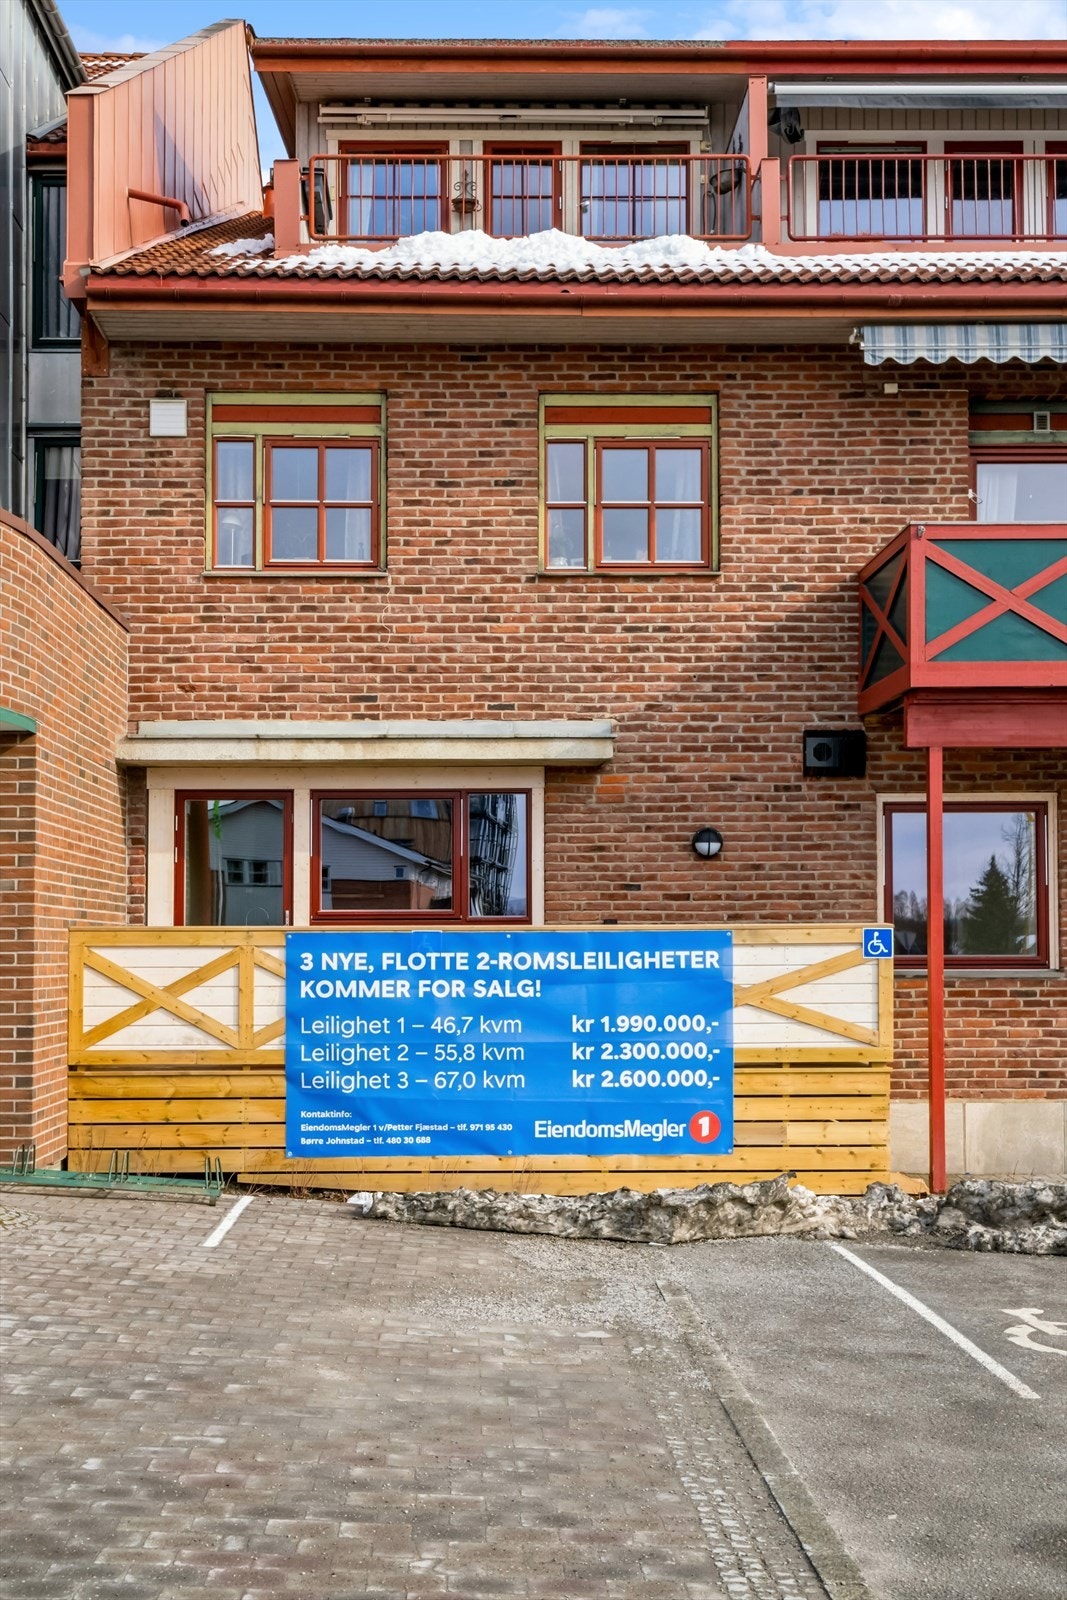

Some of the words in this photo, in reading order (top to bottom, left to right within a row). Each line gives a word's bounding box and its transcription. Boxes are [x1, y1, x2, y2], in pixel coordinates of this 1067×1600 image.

[300, 952, 314, 971] 3
[321, 952, 375, 974] NYE,
[381, 952, 469, 971] FLOTTE
[476, 950, 720, 971] 2-ROMSLEILIGHETER
[300, 979, 411, 999] KOMMER
[418, 979, 466, 998] FOR
[472, 979, 541, 999] SALG!
[301, 1015, 391, 1039] Leilighet
[397, 1016, 405, 1034] 1
[430, 1015, 474, 1036] 46,7
[479, 1015, 522, 1034] kvm
[571, 1014, 595, 1033] kr
[600, 1014, 720, 1035] 1.990.000,-
[300, 1042, 391, 1066] Leilighet
[397, 1044, 409, 1061] 2
[434, 1043, 476, 1063] 55,8
[482, 1042, 525, 1062] kvm
[572, 1042, 595, 1060] kr
[600, 1041, 721, 1062] 2.300.000,-
[301, 1070, 391, 1094] Leilighet
[397, 1071, 409, 1089] 3
[434, 1071, 476, 1091] 67,0
[483, 1070, 525, 1089] kvm
[572, 1069, 596, 1088] kr
[601, 1069, 720, 1089] 2.600.000,-
[300, 1110, 352, 1118] Kontaktinfo:
[300, 1123, 371, 1133] EiendomsMegler
[378, 1123, 414, 1132] v/Petter
[415, 1123, 449, 1133] Fjæstad
[456, 1123, 468, 1131] tlf.
[469, 1123, 484, 1131] 971
[485, 1123, 496, 1131] 95
[497, 1123, 513, 1131] 430
[534, 1118, 686, 1142] EiendomsMegler
[300, 1137, 324, 1145] Børre
[325, 1136, 365, 1145] Johnstad
[373, 1136, 384, 1145] tlf.
[385, 1136, 402, 1145] 480
[403, 1136, 415, 1144] 30
[416, 1136, 432, 1144] 688
